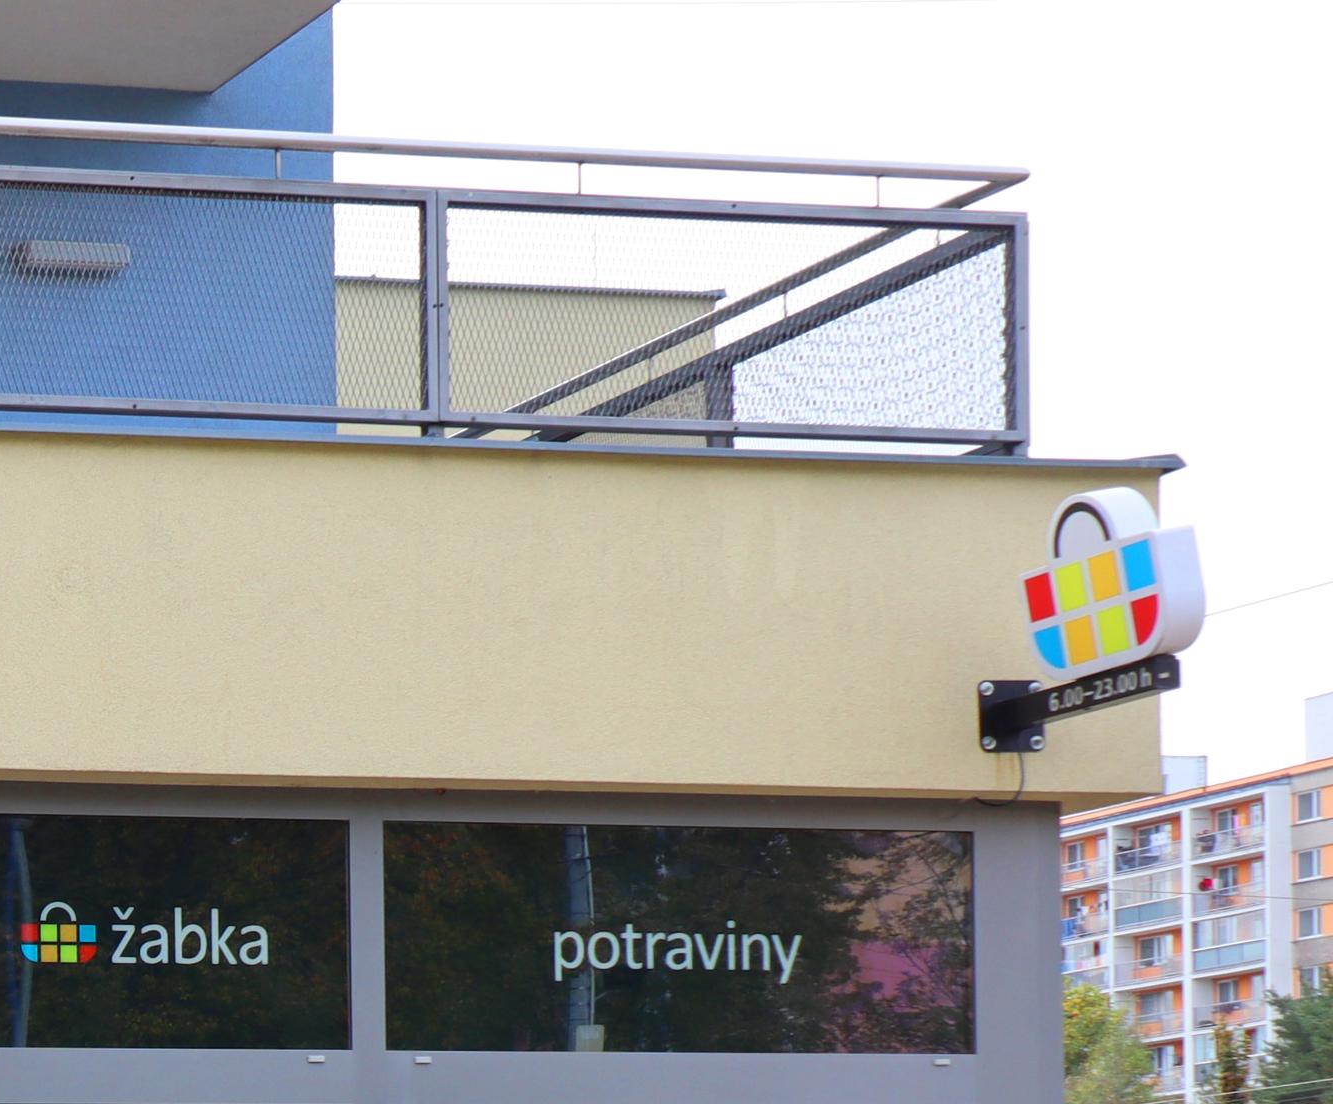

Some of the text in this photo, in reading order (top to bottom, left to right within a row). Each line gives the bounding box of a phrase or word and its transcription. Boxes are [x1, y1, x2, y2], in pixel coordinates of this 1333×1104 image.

[1139, 669, 1152, 687] h
[110, 907, 269, 966] žabka
[552, 920, 801, 985] potraviny
